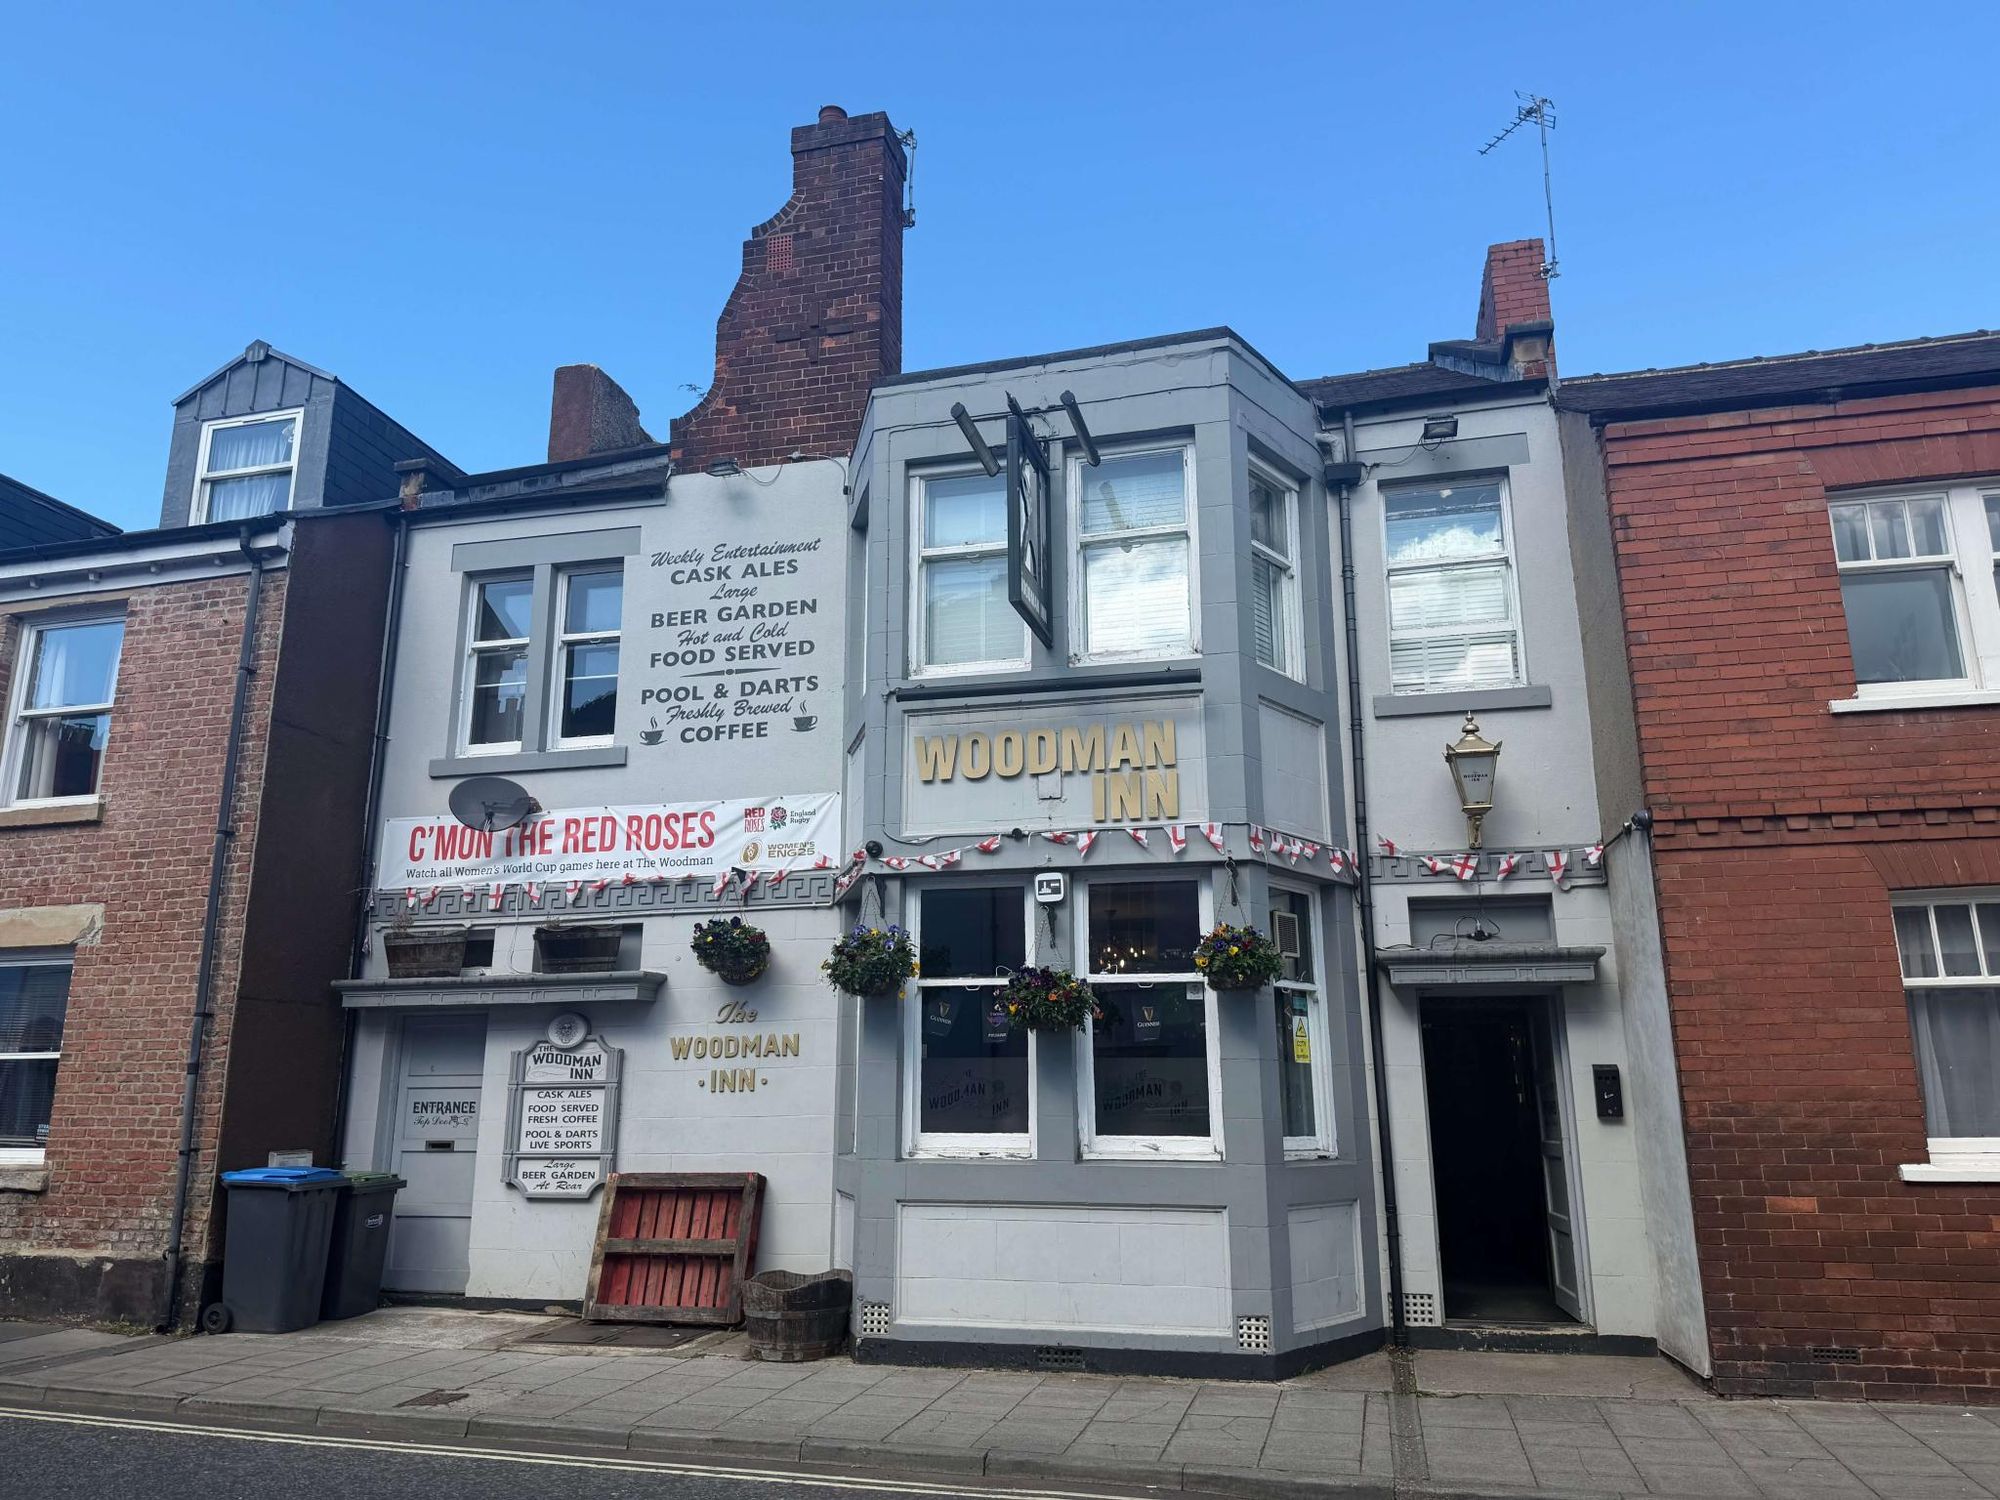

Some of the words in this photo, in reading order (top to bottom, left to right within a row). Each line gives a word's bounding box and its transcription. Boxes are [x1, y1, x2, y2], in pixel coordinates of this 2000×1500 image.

[651, 548, 704, 567] Weekly
[711, 538, 821, 562] Entertainment
[670, 565, 732, 585] CASK
[741, 559, 798, 578] ALES
[710, 583, 758, 602] Large
[651, 608, 708, 628] BEER
[717, 599, 817, 622] GARDEN
[677, 629, 708, 647] Hot
[713, 626, 745, 643] and
[750, 621, 789, 642] Cold
[650, 648, 716, 668] FOOD
[724, 640, 816, 662] SERVED
[641, 685, 704, 705] POOL
[713, 682, 729, 699] &
[740, 675, 819, 697] DARTS
[666, 701, 725, 725] Freshly
[733, 696, 794, 717] Brewed
[680, 721, 768, 744] COFFEE
[913, 719, 1178, 782] WOODMAN
[1092, 769, 1179, 823] INN
[744, 807, 765, 818] RED
[790, 809, 816, 818] England
[744, 818, 765, 833] ROSES
[408, 824, 494, 862] C'MON
[562, 816, 617, 854] RED
[626, 811, 716, 852] ROSES
[768, 841, 815, 850] WOMEN'S
[768, 848, 815, 858] ENG25
[406, 868, 437, 878] Watch
[440, 868, 452, 877] all
[455, 865, 500, 876] Women's
[503, 862, 533, 874] World
[535, 862, 557, 875] Cup
[560, 861, 594, 874] games
[596, 859, 620, 869] here
[623, 858, 633, 869] at
[636, 858, 656, 868] The
[659, 856, 714, 867] Woodman
[715, 1001, 758, 1024] The
[670, 1033, 800, 1060] WOODMAN
[533, 1053, 602, 1067] WOODMAN
[570, 1068, 593, 1079] INN
[710, 1068, 756, 1093] INN
[568, 1090, 592, 1098] ALES
[413, 1101, 477, 1115] ENTRANCE
[528, 1105, 556, 1113] FOOD
[561, 1104, 599, 1112] SERVED
[528, 1115, 557, 1123] FRESH
[562, 1115, 598, 1123] COFFEE
[566, 1130, 598, 1138] DARTS
[530, 1141, 550, 1149] LIVE
[554, 1141, 592, 1149] SPORTS
[544, 1159, 575, 1170] Large
[551, 1171, 596, 1179] GARDEN
[533, 1180, 550, 1190] At
[555, 1181, 582, 1190] Rear
